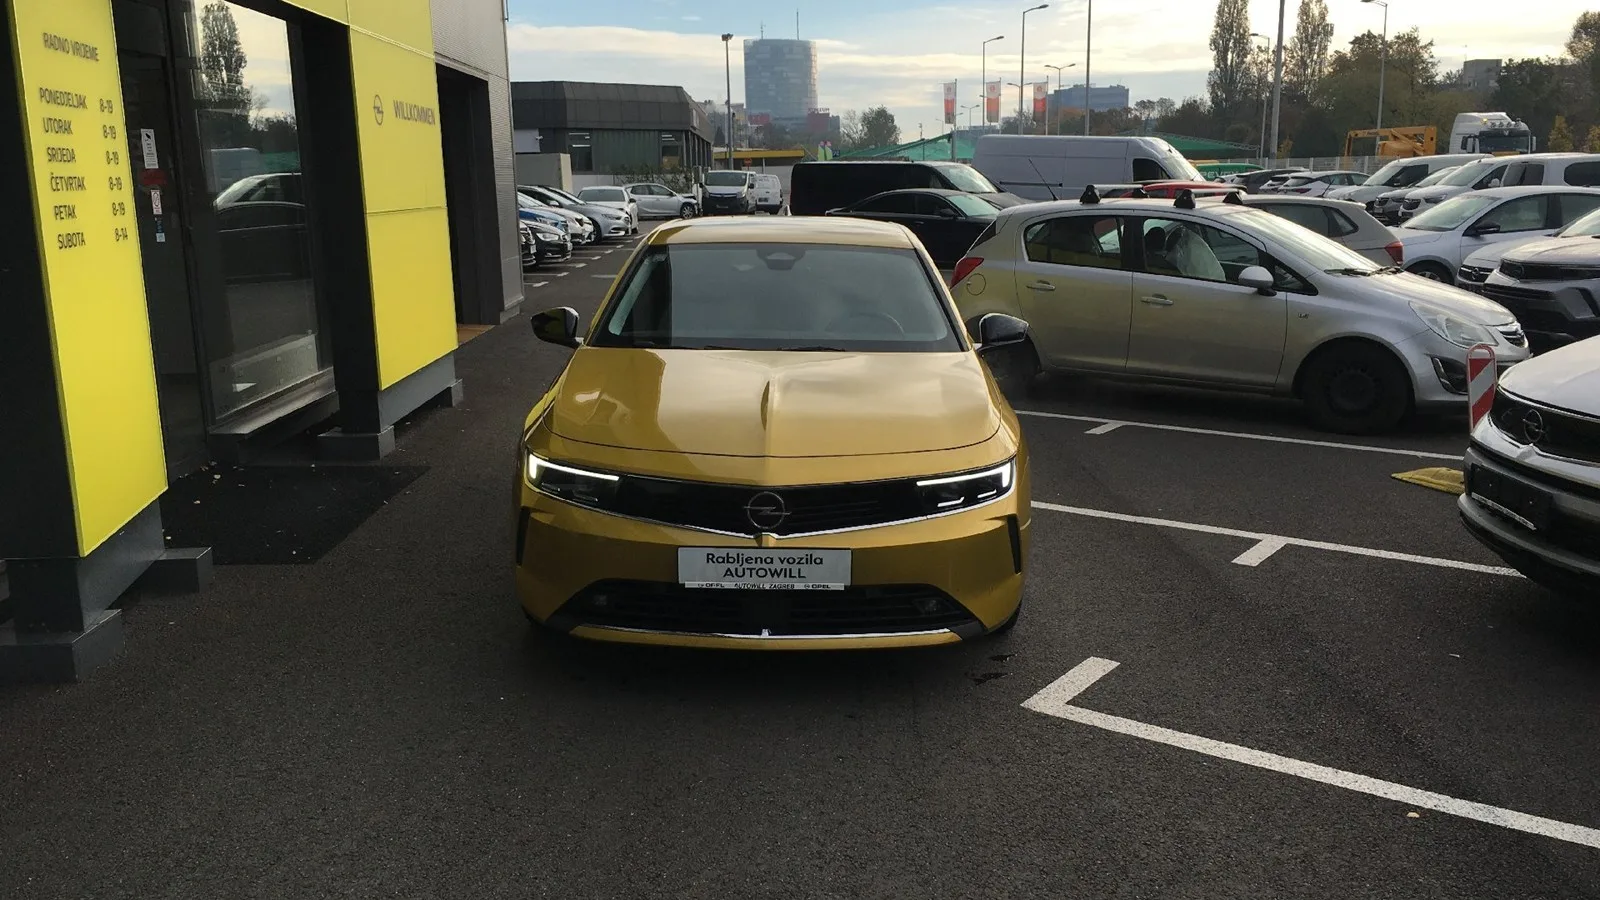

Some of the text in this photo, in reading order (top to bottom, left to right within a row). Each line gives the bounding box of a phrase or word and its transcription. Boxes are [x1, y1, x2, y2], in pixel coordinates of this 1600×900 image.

[43, 32, 99, 61] RADNO VRIJEME
[39, 87, 113, 114] PONEDJELJAK 8-19
[393, 99, 436, 126] WILLKOMMEN
[43, 117, 116, 139] UTORAK 8-19
[47, 147, 119, 165] SRIJEDA 8-19
[50, 172, 122, 192] ČETVRTAK 8-19
[54, 201, 125, 220] PETAK 8-19
[57, 227, 128, 249] SUBOTA 8-14
[706, 552, 824, 567] Rabljena vozila
[723, 567, 807, 579] AUTOWILL
